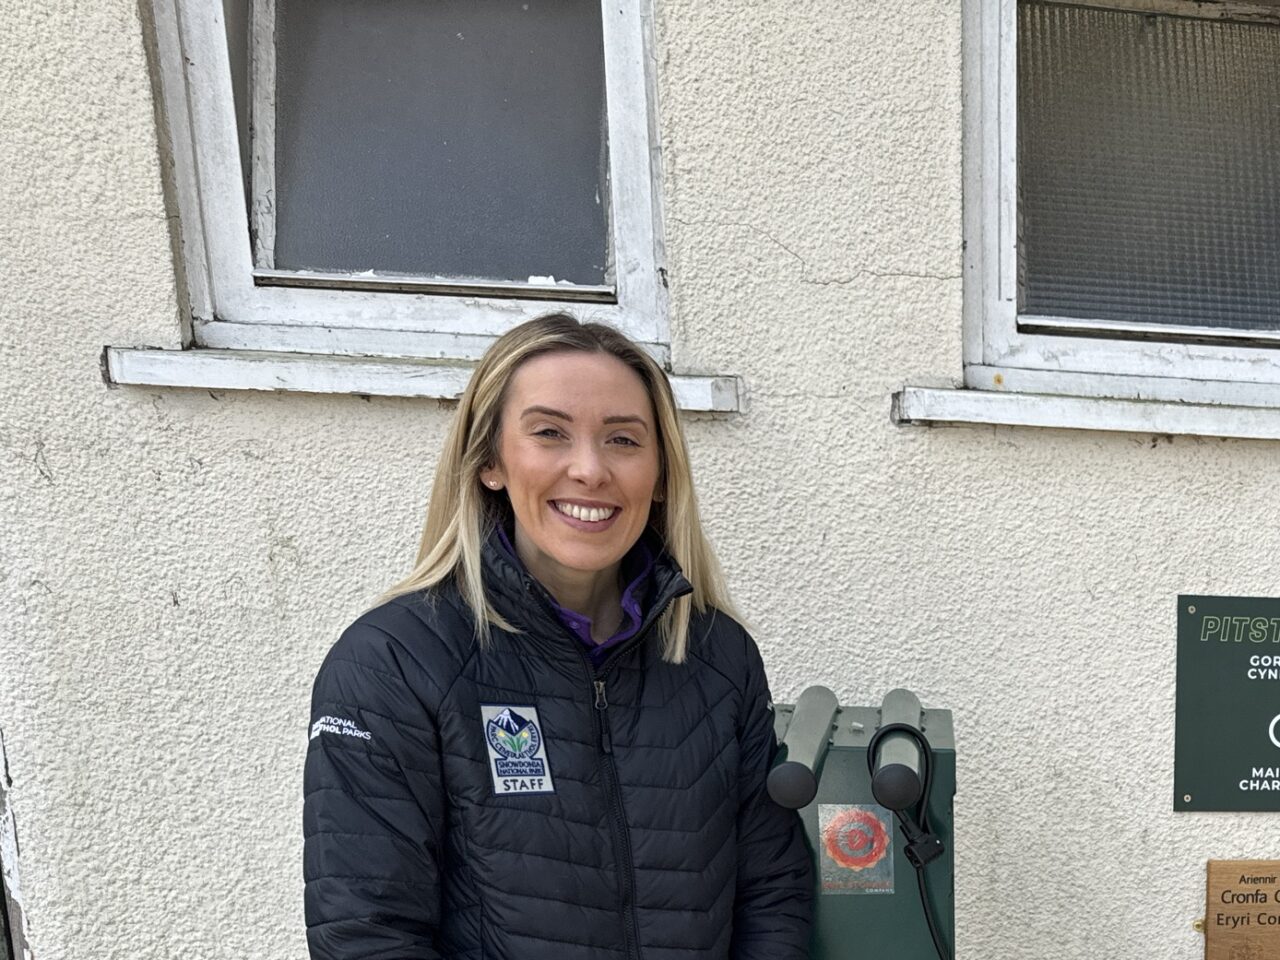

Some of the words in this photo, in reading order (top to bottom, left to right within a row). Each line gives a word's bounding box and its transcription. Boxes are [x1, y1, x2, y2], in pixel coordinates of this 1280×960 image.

[503, 778, 544, 791] STAFF
[1239, 875, 1277, 884] Ariennir
[1221, 889, 1268, 904] Cronfa
[1216, 912, 1250, 929] Eryri
